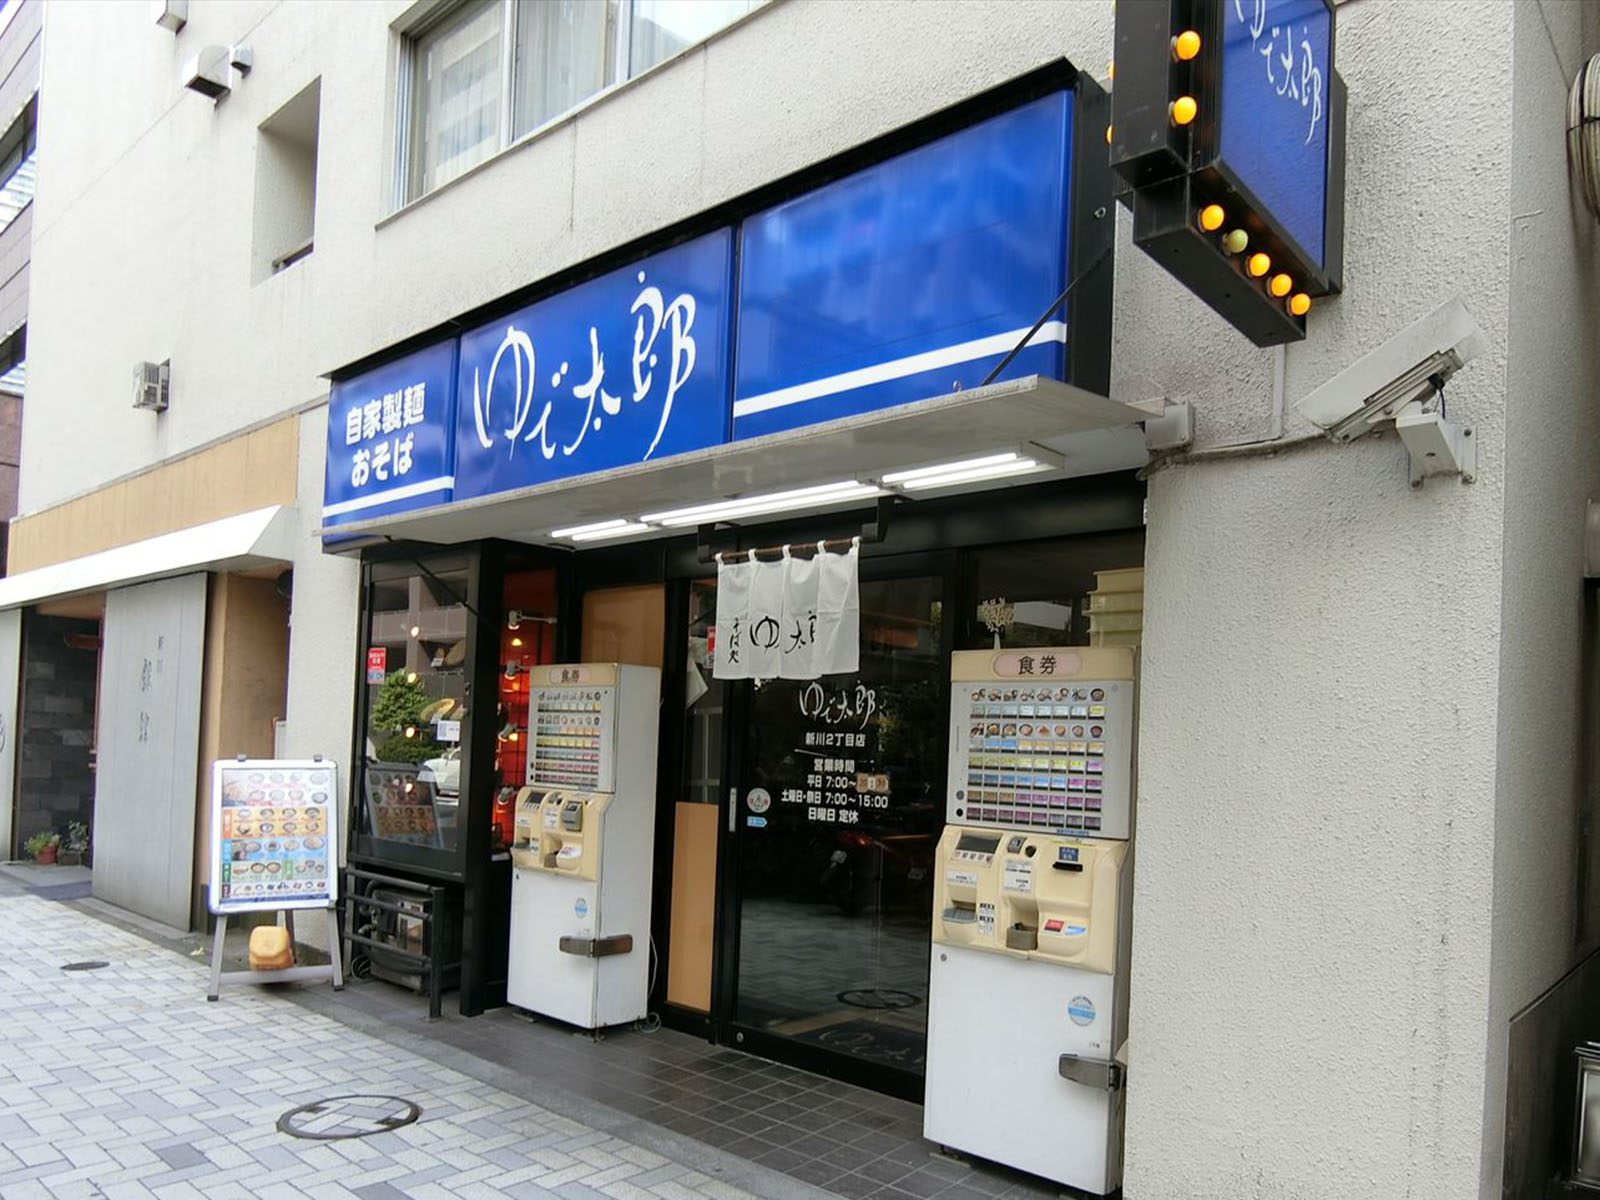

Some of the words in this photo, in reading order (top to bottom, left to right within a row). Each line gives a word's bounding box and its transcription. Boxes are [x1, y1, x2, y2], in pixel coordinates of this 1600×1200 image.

[474, 270, 697, 462] ゆで太郎
[345, 381, 426, 446] 自家製麺
[351, 431, 414, 488] おそば
[1018, 655, 1057, 676] 食券
[799, 680, 876, 730] ゆで太郎
[805, 732, 866, 747] 新川2丁目店
[814, 758, 855, 773] 営業時間
[807, 774, 823, 788] 平日
[808, 807, 836, 822] 日曜日
[839, 810, 860, 824] 定休
